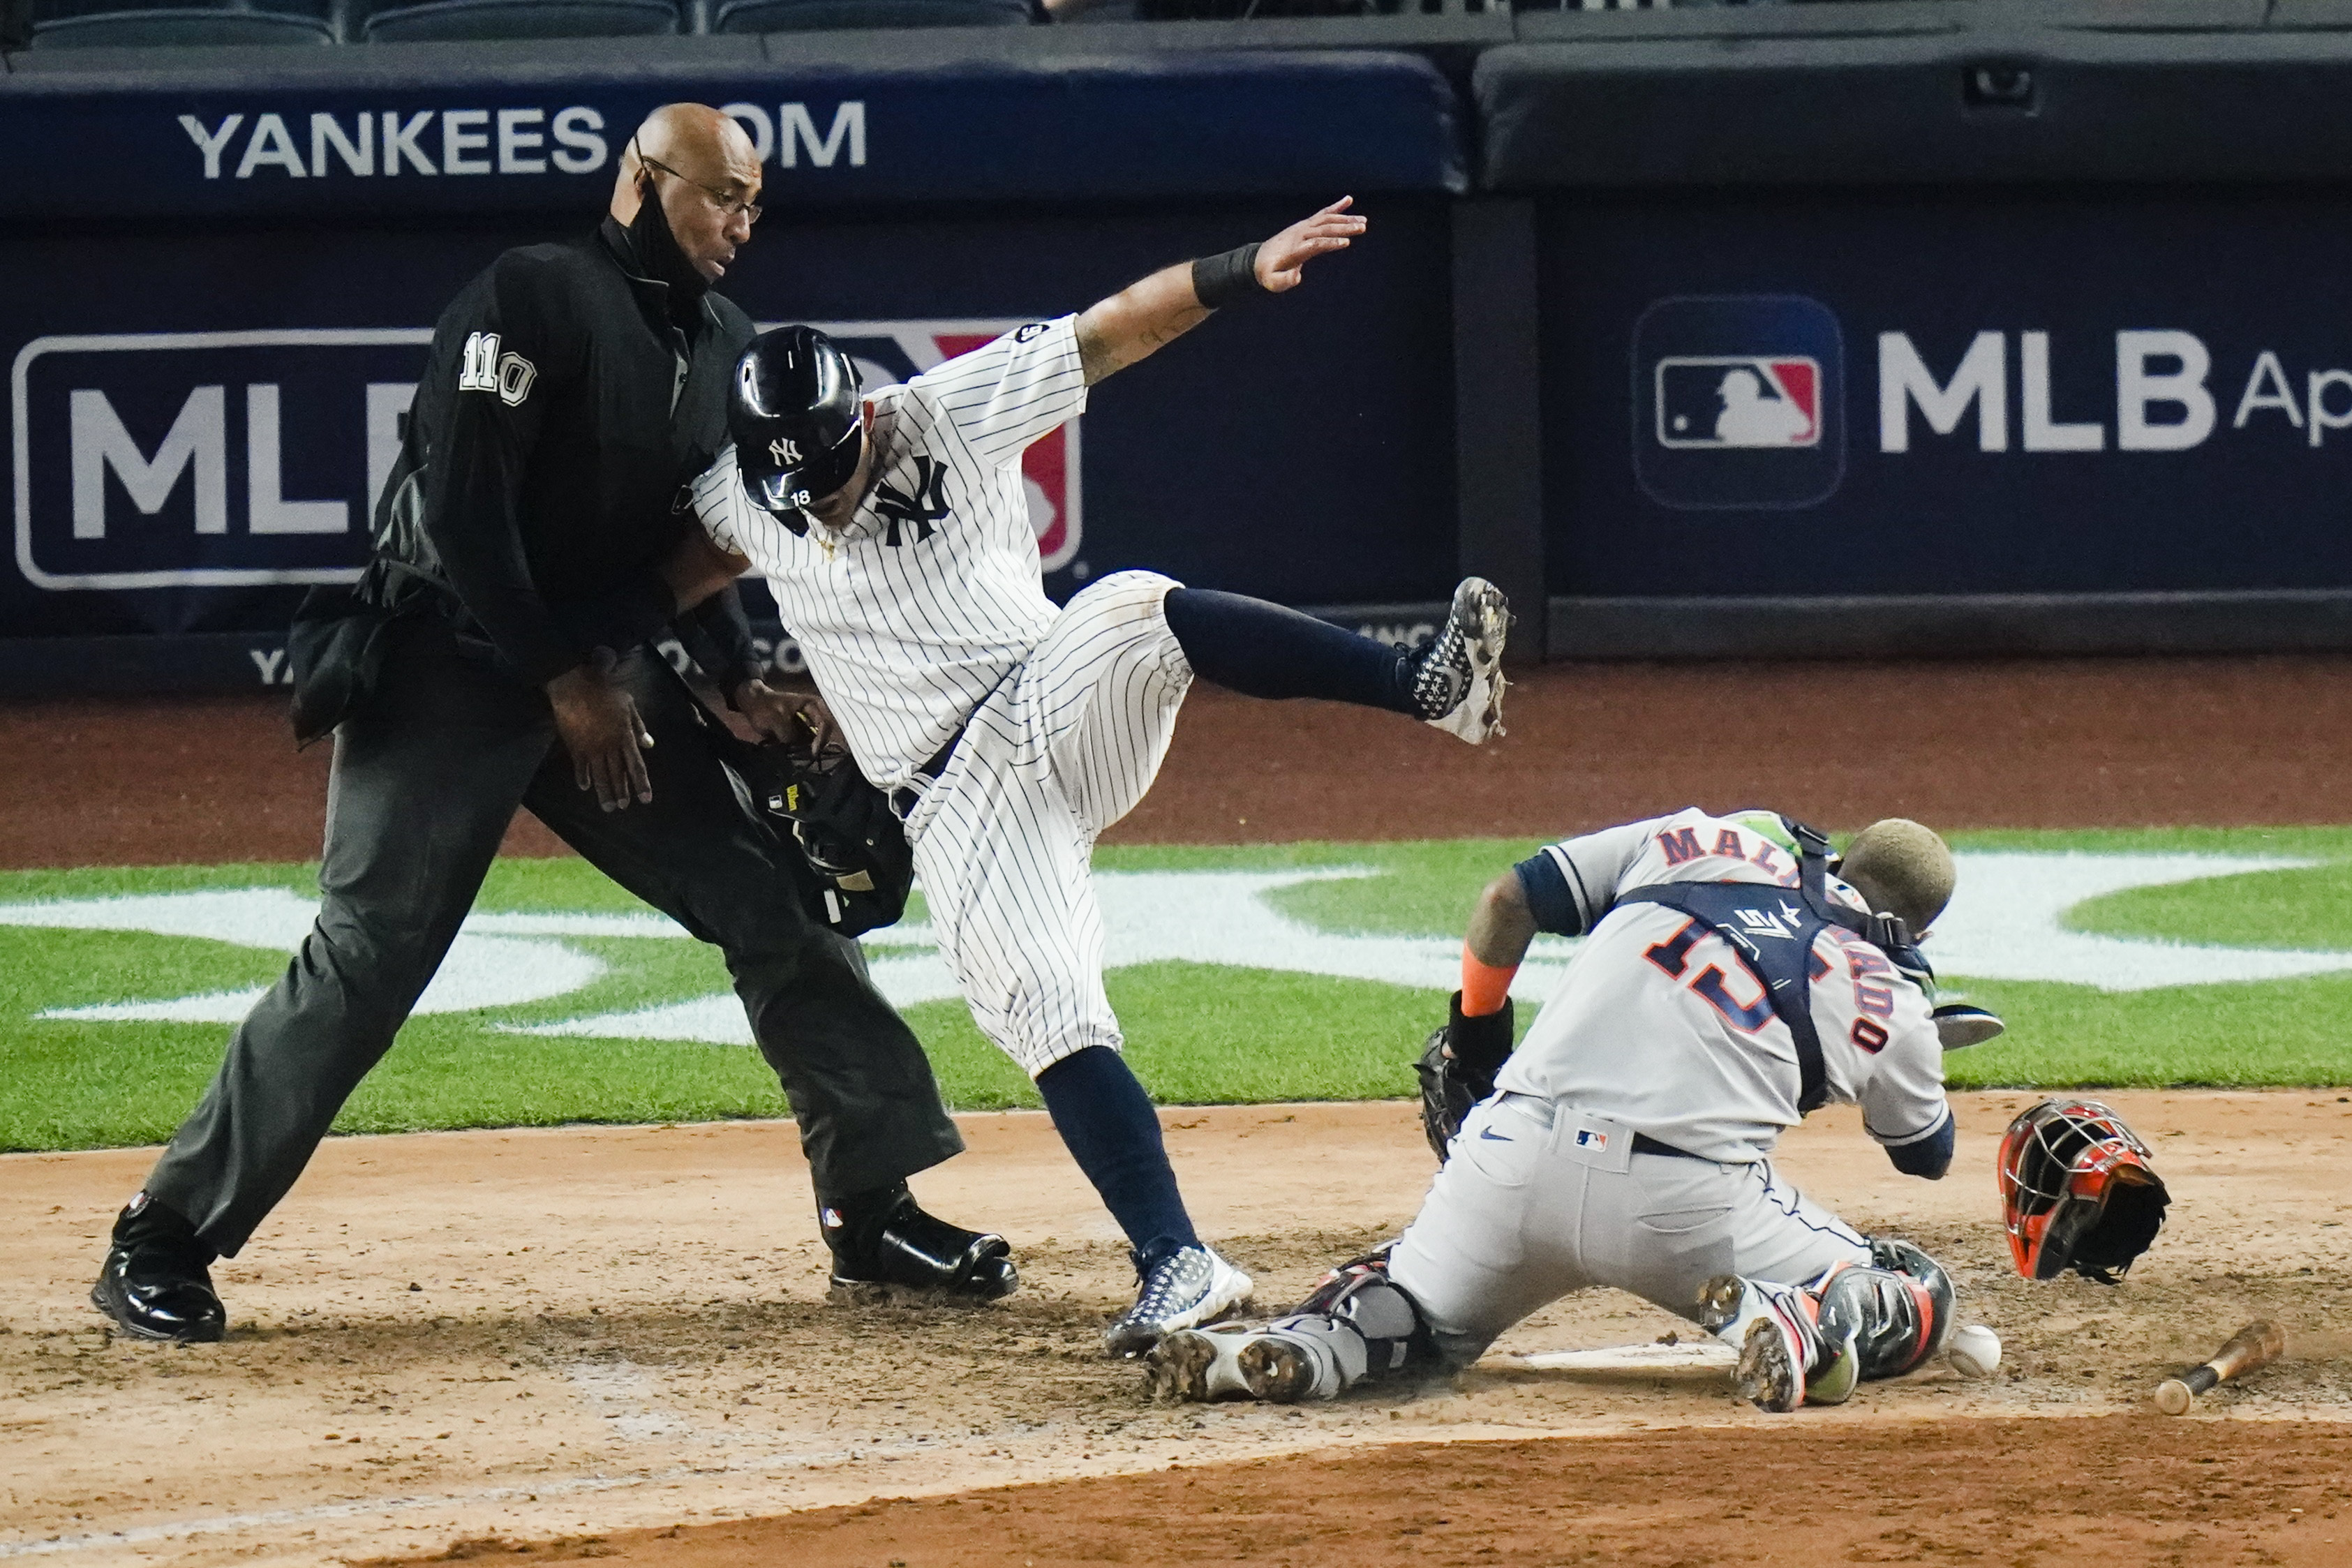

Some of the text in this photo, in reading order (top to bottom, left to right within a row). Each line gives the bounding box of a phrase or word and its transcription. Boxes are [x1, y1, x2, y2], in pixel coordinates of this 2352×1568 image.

[459, 331, 538, 408] 110
[1880, 330, 2217, 454] MLB
[768, 437, 803, 467] NY
[790, 490, 811, 507] 18
[874, 454, 952, 547] NY
